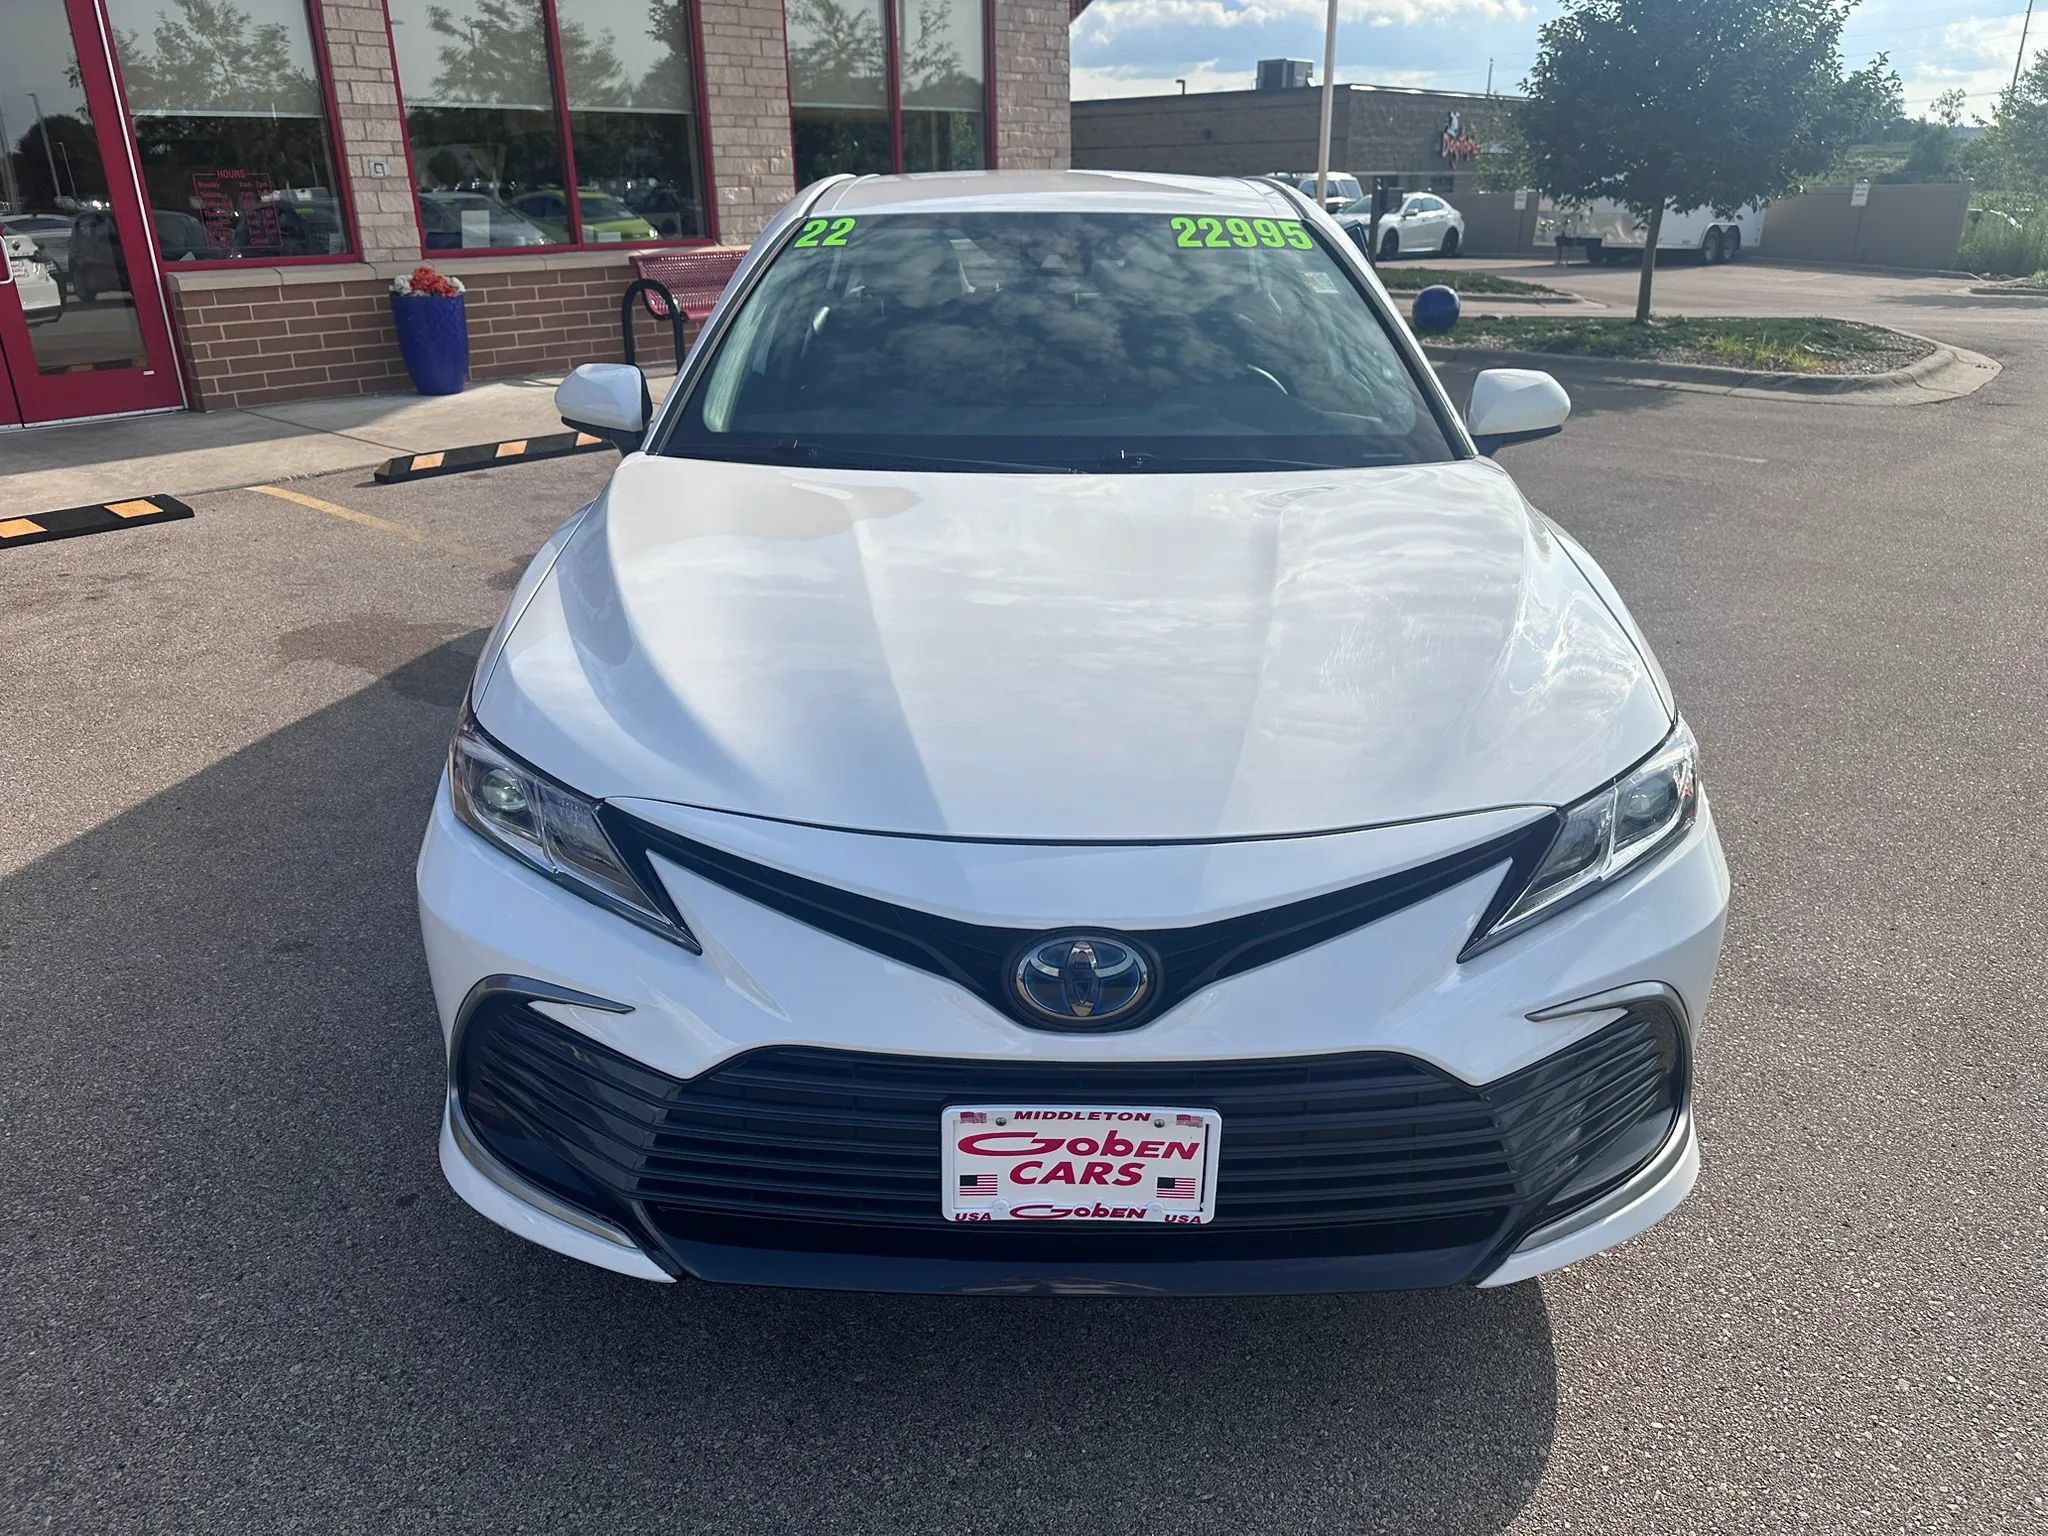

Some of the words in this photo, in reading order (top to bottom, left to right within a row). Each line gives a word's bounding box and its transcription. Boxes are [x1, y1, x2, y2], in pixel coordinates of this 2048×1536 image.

[216, 169, 246, 179] HOURS
[793, 217, 856, 248] 22
[1170, 216, 1313, 250] 22995
[1013, 1110, 1151, 1122] MIDDLETON
[1009, 1160, 1146, 1186] CARS
[954, 1212, 992, 1223] USA
[1163, 1213, 1202, 1224] USA
